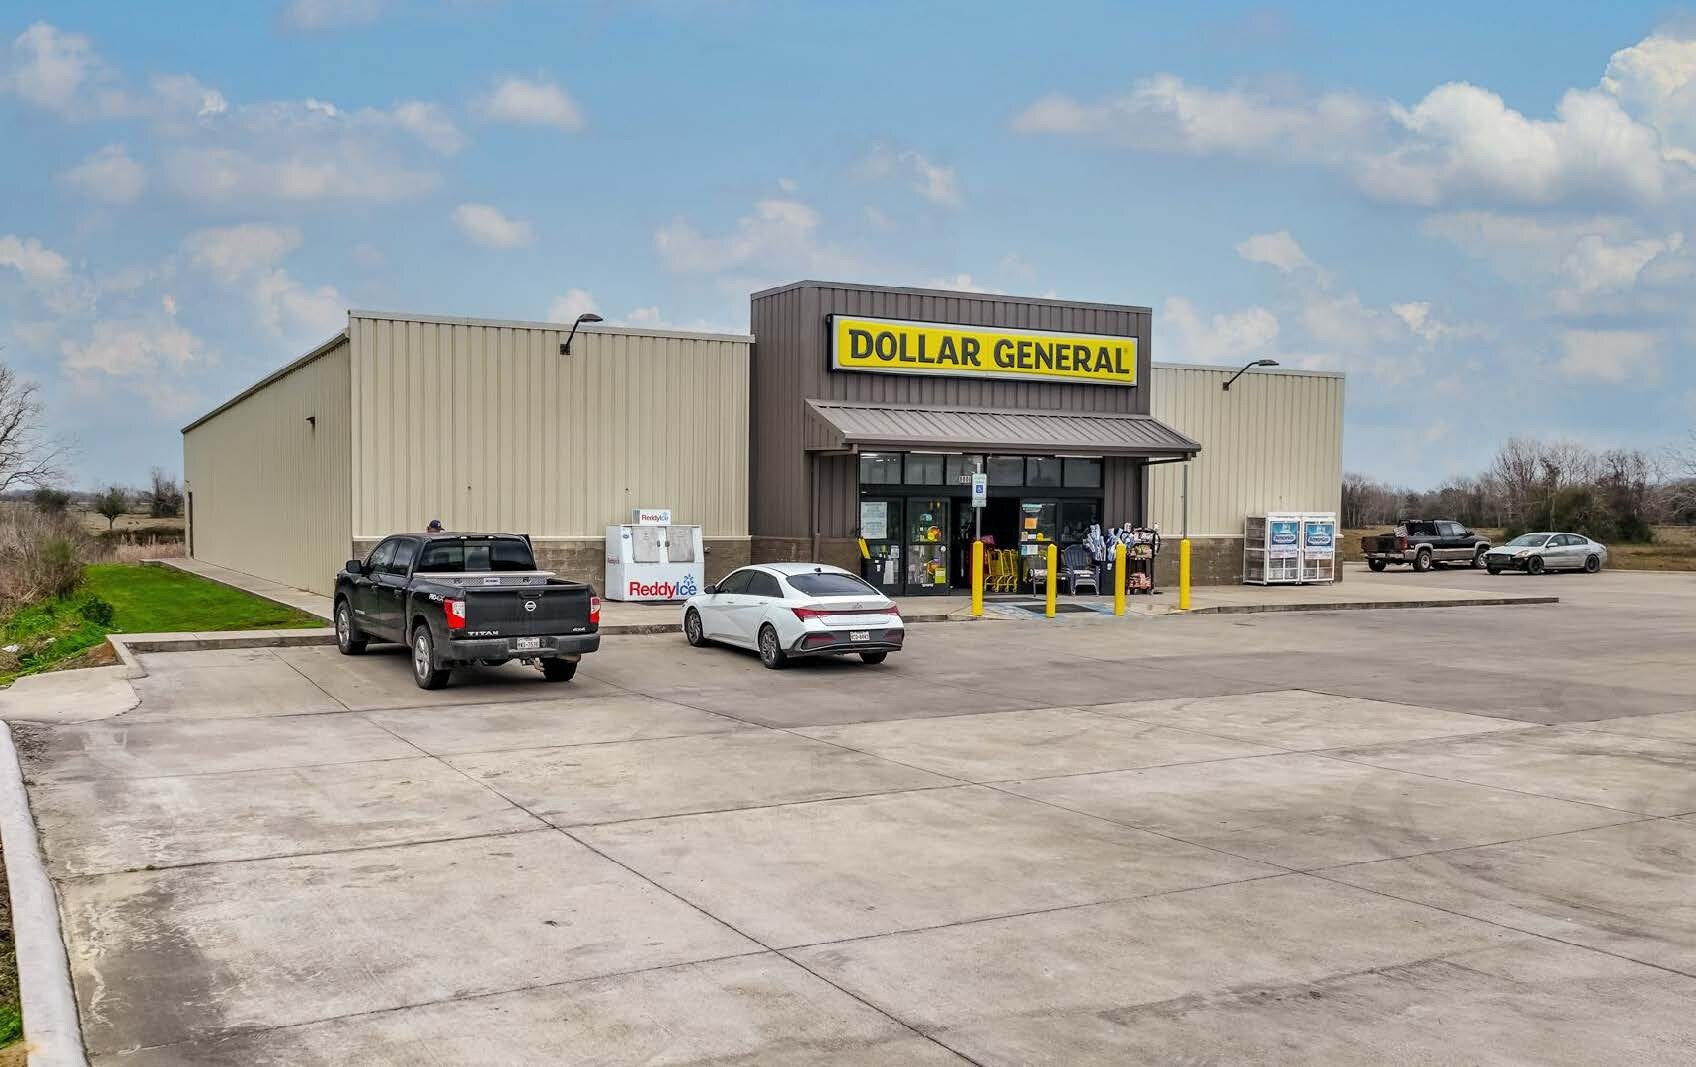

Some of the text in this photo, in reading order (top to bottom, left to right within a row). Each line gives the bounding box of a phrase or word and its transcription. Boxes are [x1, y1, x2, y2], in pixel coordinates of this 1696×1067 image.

[848, 328, 1130, 374] DOLLAR GENERAL
[629, 580, 697, 599] ReddyIce
